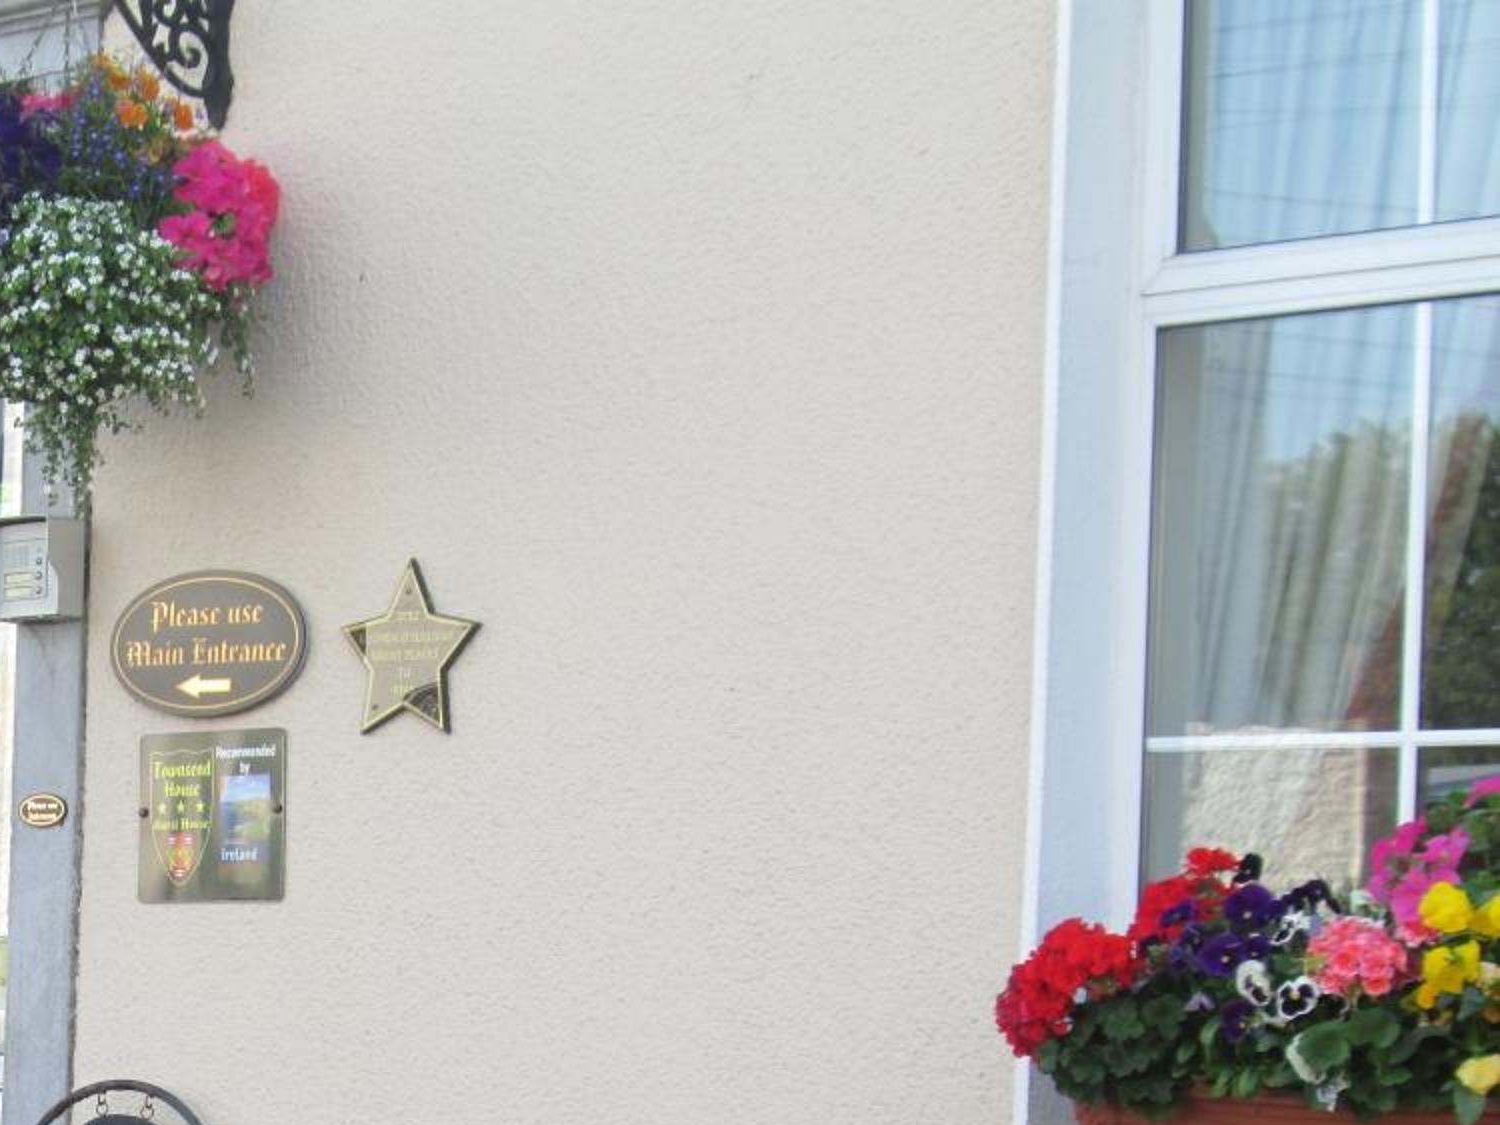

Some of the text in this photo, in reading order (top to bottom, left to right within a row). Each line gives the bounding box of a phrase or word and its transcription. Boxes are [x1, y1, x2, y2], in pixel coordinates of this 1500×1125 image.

[152, 600, 263, 633] Please use
[126, 637, 287, 667] Main Entrance
[221, 848, 259, 863] Ireland
